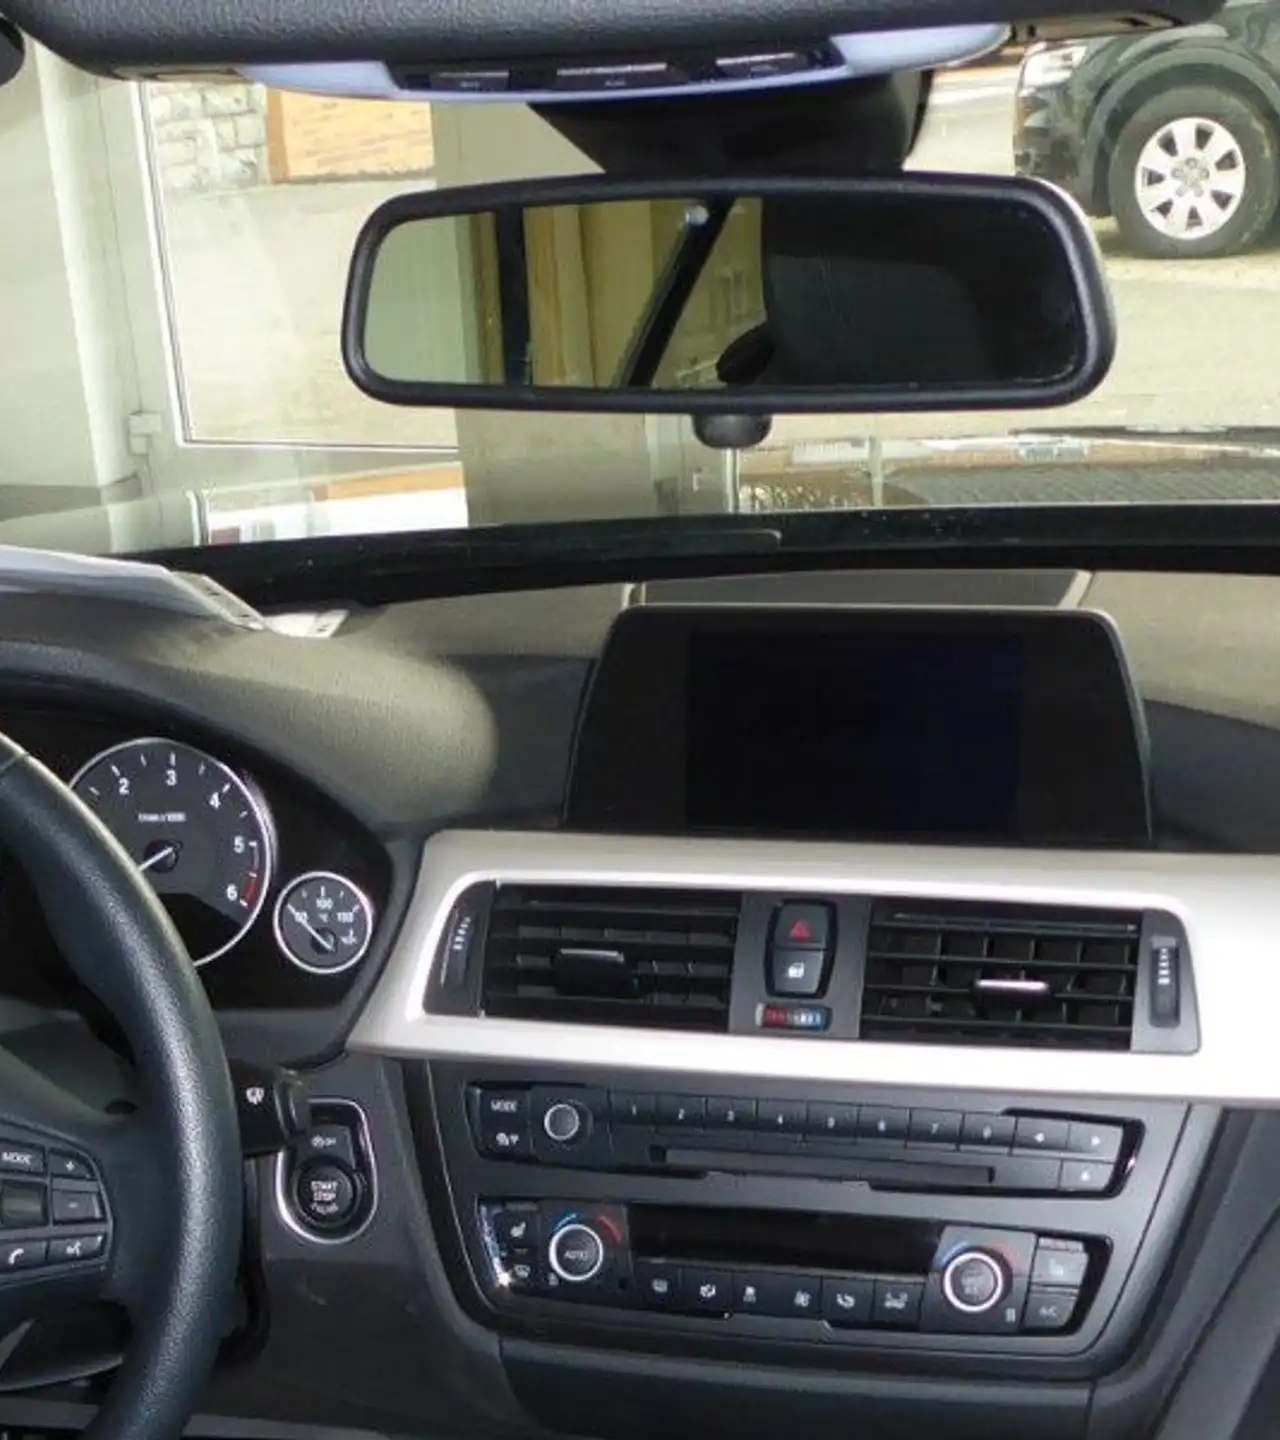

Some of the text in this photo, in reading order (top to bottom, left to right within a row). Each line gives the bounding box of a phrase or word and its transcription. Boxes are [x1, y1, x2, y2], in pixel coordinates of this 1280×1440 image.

[166, 770, 177, 786] 3
[119, 778, 130, 795] 2
[209, 792, 221, 809] 4
[233, 837, 245, 853] 5
[226, 884, 238, 900] 6
